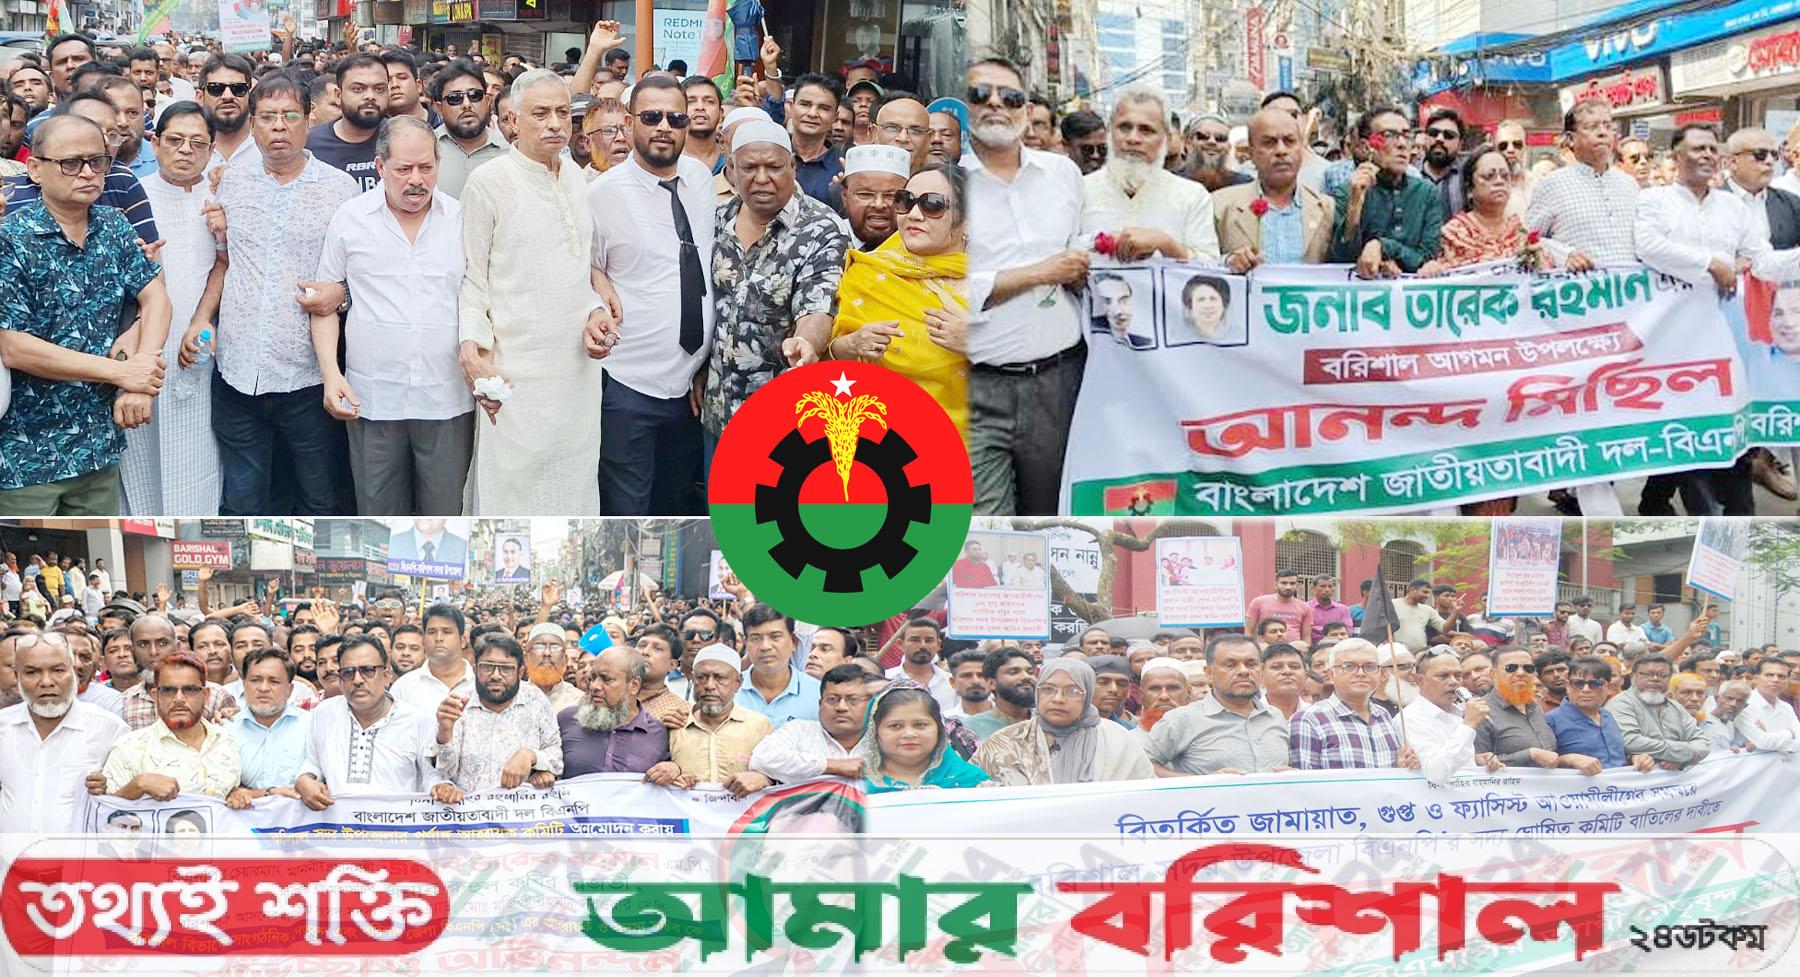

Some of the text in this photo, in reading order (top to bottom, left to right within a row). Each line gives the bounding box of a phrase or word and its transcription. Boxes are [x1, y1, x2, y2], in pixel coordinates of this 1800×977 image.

[663, 29, 696, 39] Note
[664, 17, 703, 28] REDMI
[1262, 284, 1392, 334] জনাব
[1402, 284, 1519, 337] তারেক
[1529, 267, 1651, 319] রহমান
[1320, 351, 1418, 381] বরিশাল
[1426, 346, 1510, 373] আগমন
[1179, 357, 1732, 460] আনন্দ মিছিল
[1750, 404, 1800, 438] বরি
[1193, 473, 1372, 512] বাংলাদেশ
[1379, 441, 1590, 499] জাতীয়তাবাদী
[173, 543, 218, 553] BARISHAL
[352, 801, 591, 824] বাংলাদেশ জাতীয়তাবাদী দল বিএনপি
[1114, 807, 1240, 846] বিতর্কিত
[1247, 805, 1368, 834] জামায়াত,
[1377, 801, 1417, 824] গুপ্ত
[1424, 802, 1443, 820] ও
[1449, 791, 1528, 820] ফ্যাসিস্ট
[1579, 811, 1626, 834] কমিটি
[1629, 807, 1684, 830] বাতিলের
